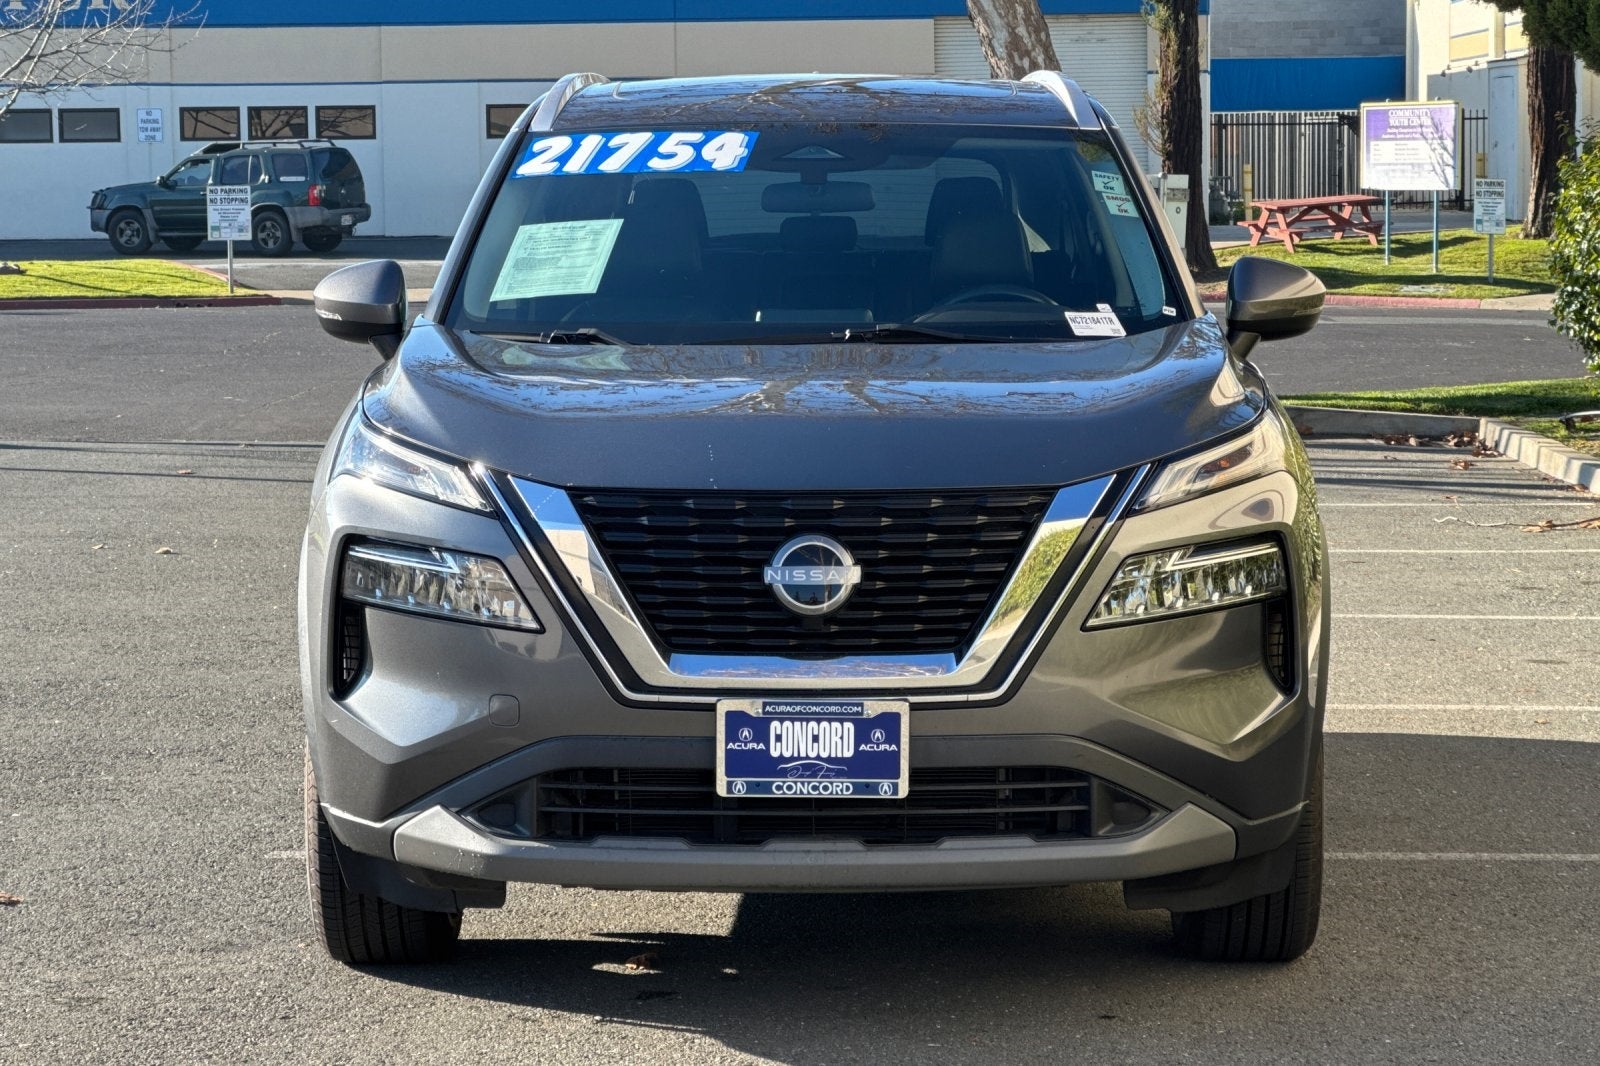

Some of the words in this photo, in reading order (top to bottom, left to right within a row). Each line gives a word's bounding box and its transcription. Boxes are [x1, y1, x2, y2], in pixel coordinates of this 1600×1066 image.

[516, 132, 748, 174] 21754
[765, 705, 862, 713] ACURAOFCONCORD.COM
[770, 720, 854, 758] CONCORD
[772, 782, 853, 795] CONCORD
